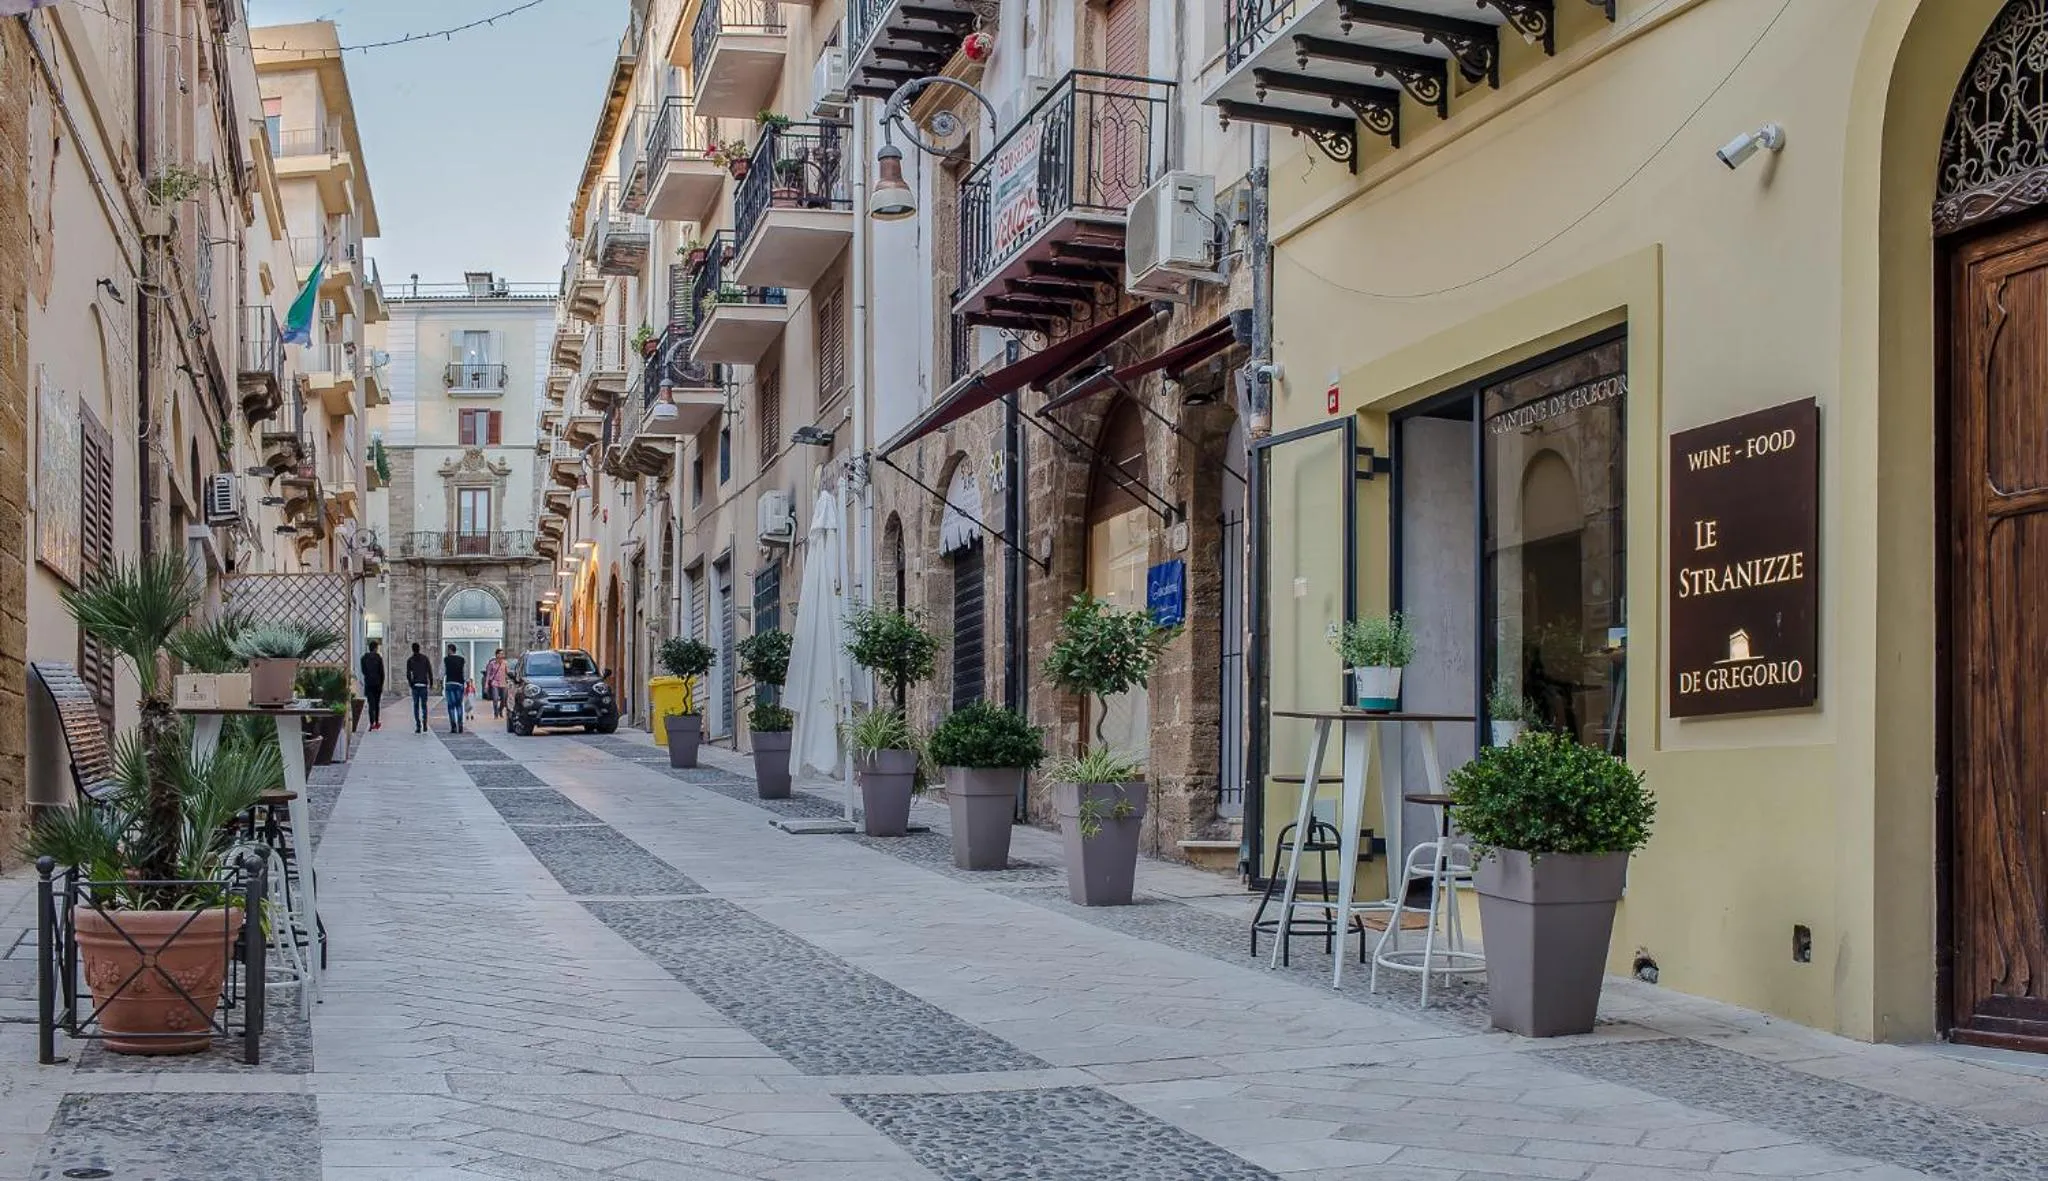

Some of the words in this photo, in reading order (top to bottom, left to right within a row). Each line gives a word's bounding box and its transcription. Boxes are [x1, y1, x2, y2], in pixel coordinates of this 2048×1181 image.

[1491, 400, 1547, 434] CANTINE
[1550, 393, 1567, 416] DE
[1688, 444, 1731, 472] WINE
[1746, 429, 1796, 459] FOOD
[1695, 519, 1717, 551] LE
[1678, 551, 1804, 598] STRANIZZE
[1680, 671, 1701, 695] DE
[1704, 659, 1803, 692] GREGORIO
